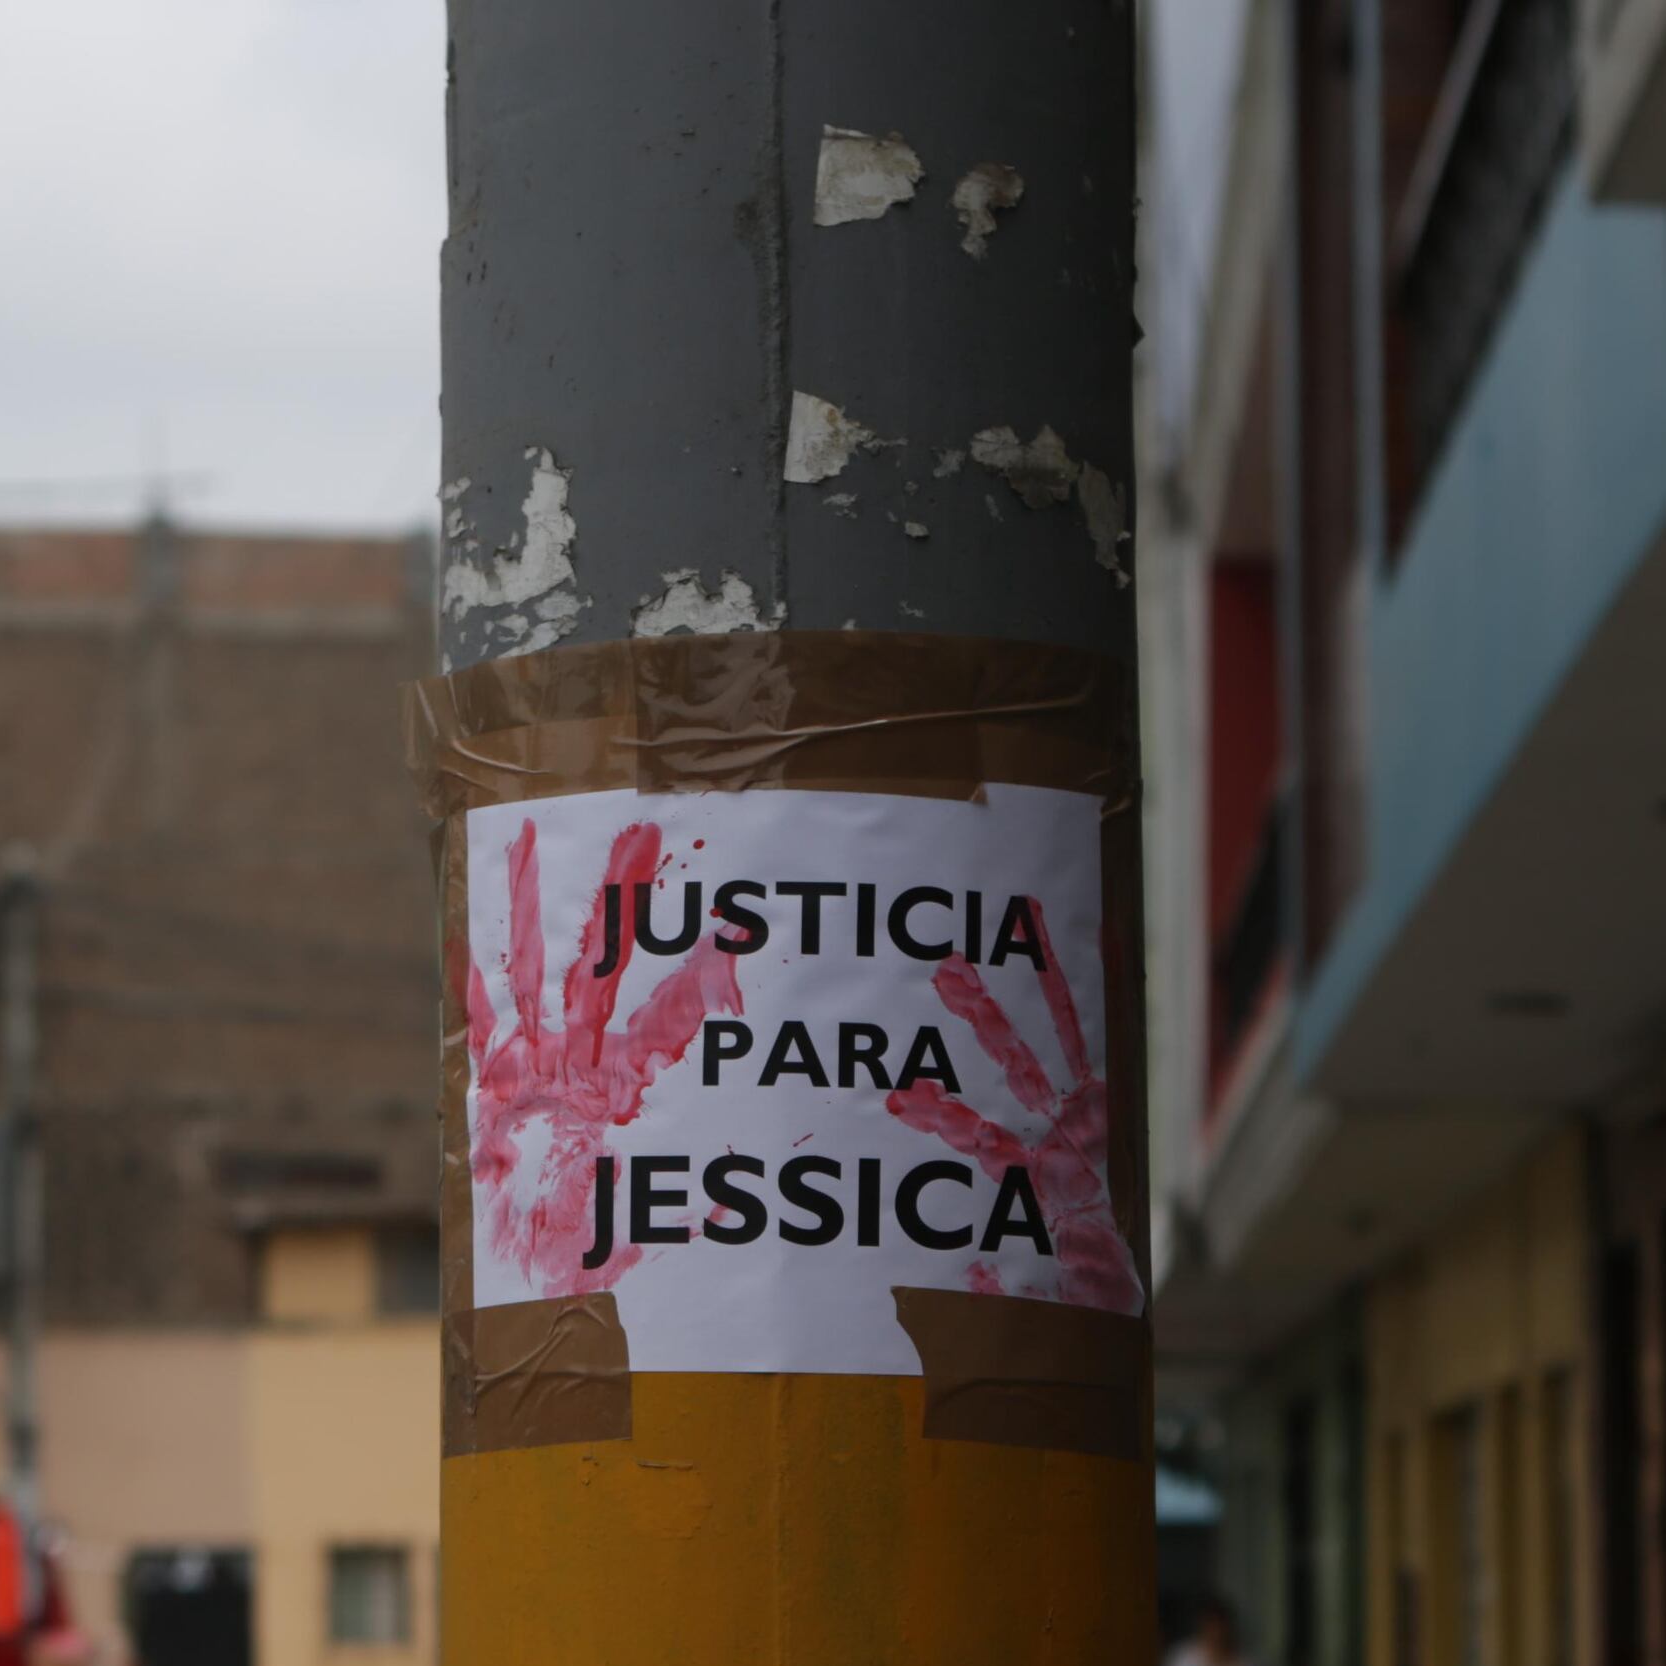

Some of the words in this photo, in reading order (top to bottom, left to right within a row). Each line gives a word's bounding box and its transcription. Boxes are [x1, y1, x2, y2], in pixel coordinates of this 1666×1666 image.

[592, 879, 1048, 979] JUSTICIA
[701, 1019, 962, 1094] PARA
[582, 1153, 1055, 1270] JESSICA
